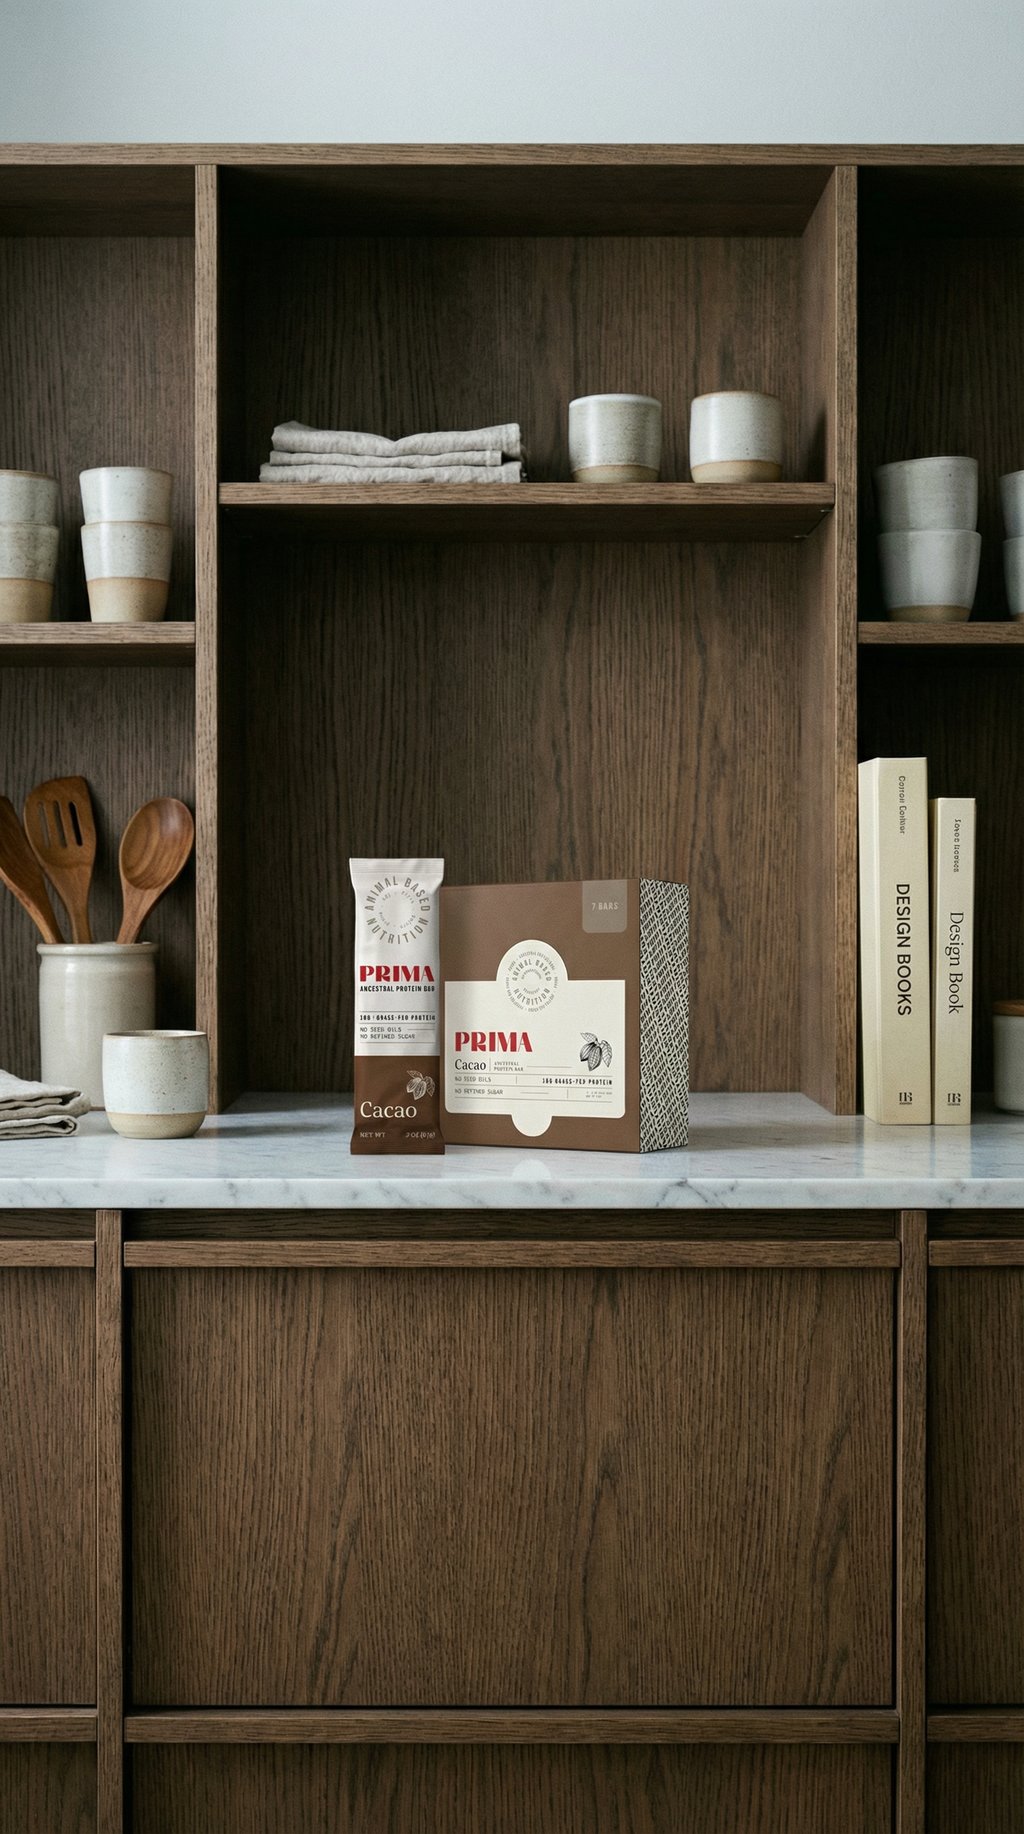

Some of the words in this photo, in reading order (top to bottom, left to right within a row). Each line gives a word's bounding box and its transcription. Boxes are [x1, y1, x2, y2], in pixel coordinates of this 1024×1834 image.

[364, 875, 399, 911] ANIMAL
[404, 877, 431, 911] BASED
[598, 902, 619, 910] BARS
[896, 884, 911, 948] DESIGN
[366, 917, 429, 945] NUTRITION
[944, 912, 964, 966] Design
[359, 965, 435, 982] PRIMA
[896, 954, 912, 1016] BOOKS
[948, 972, 964, 1014] Book
[455, 1031, 533, 1053] PRIMA
[454, 1058, 487, 1071] Cacao
[360, 1101, 417, 1118] Cacao
